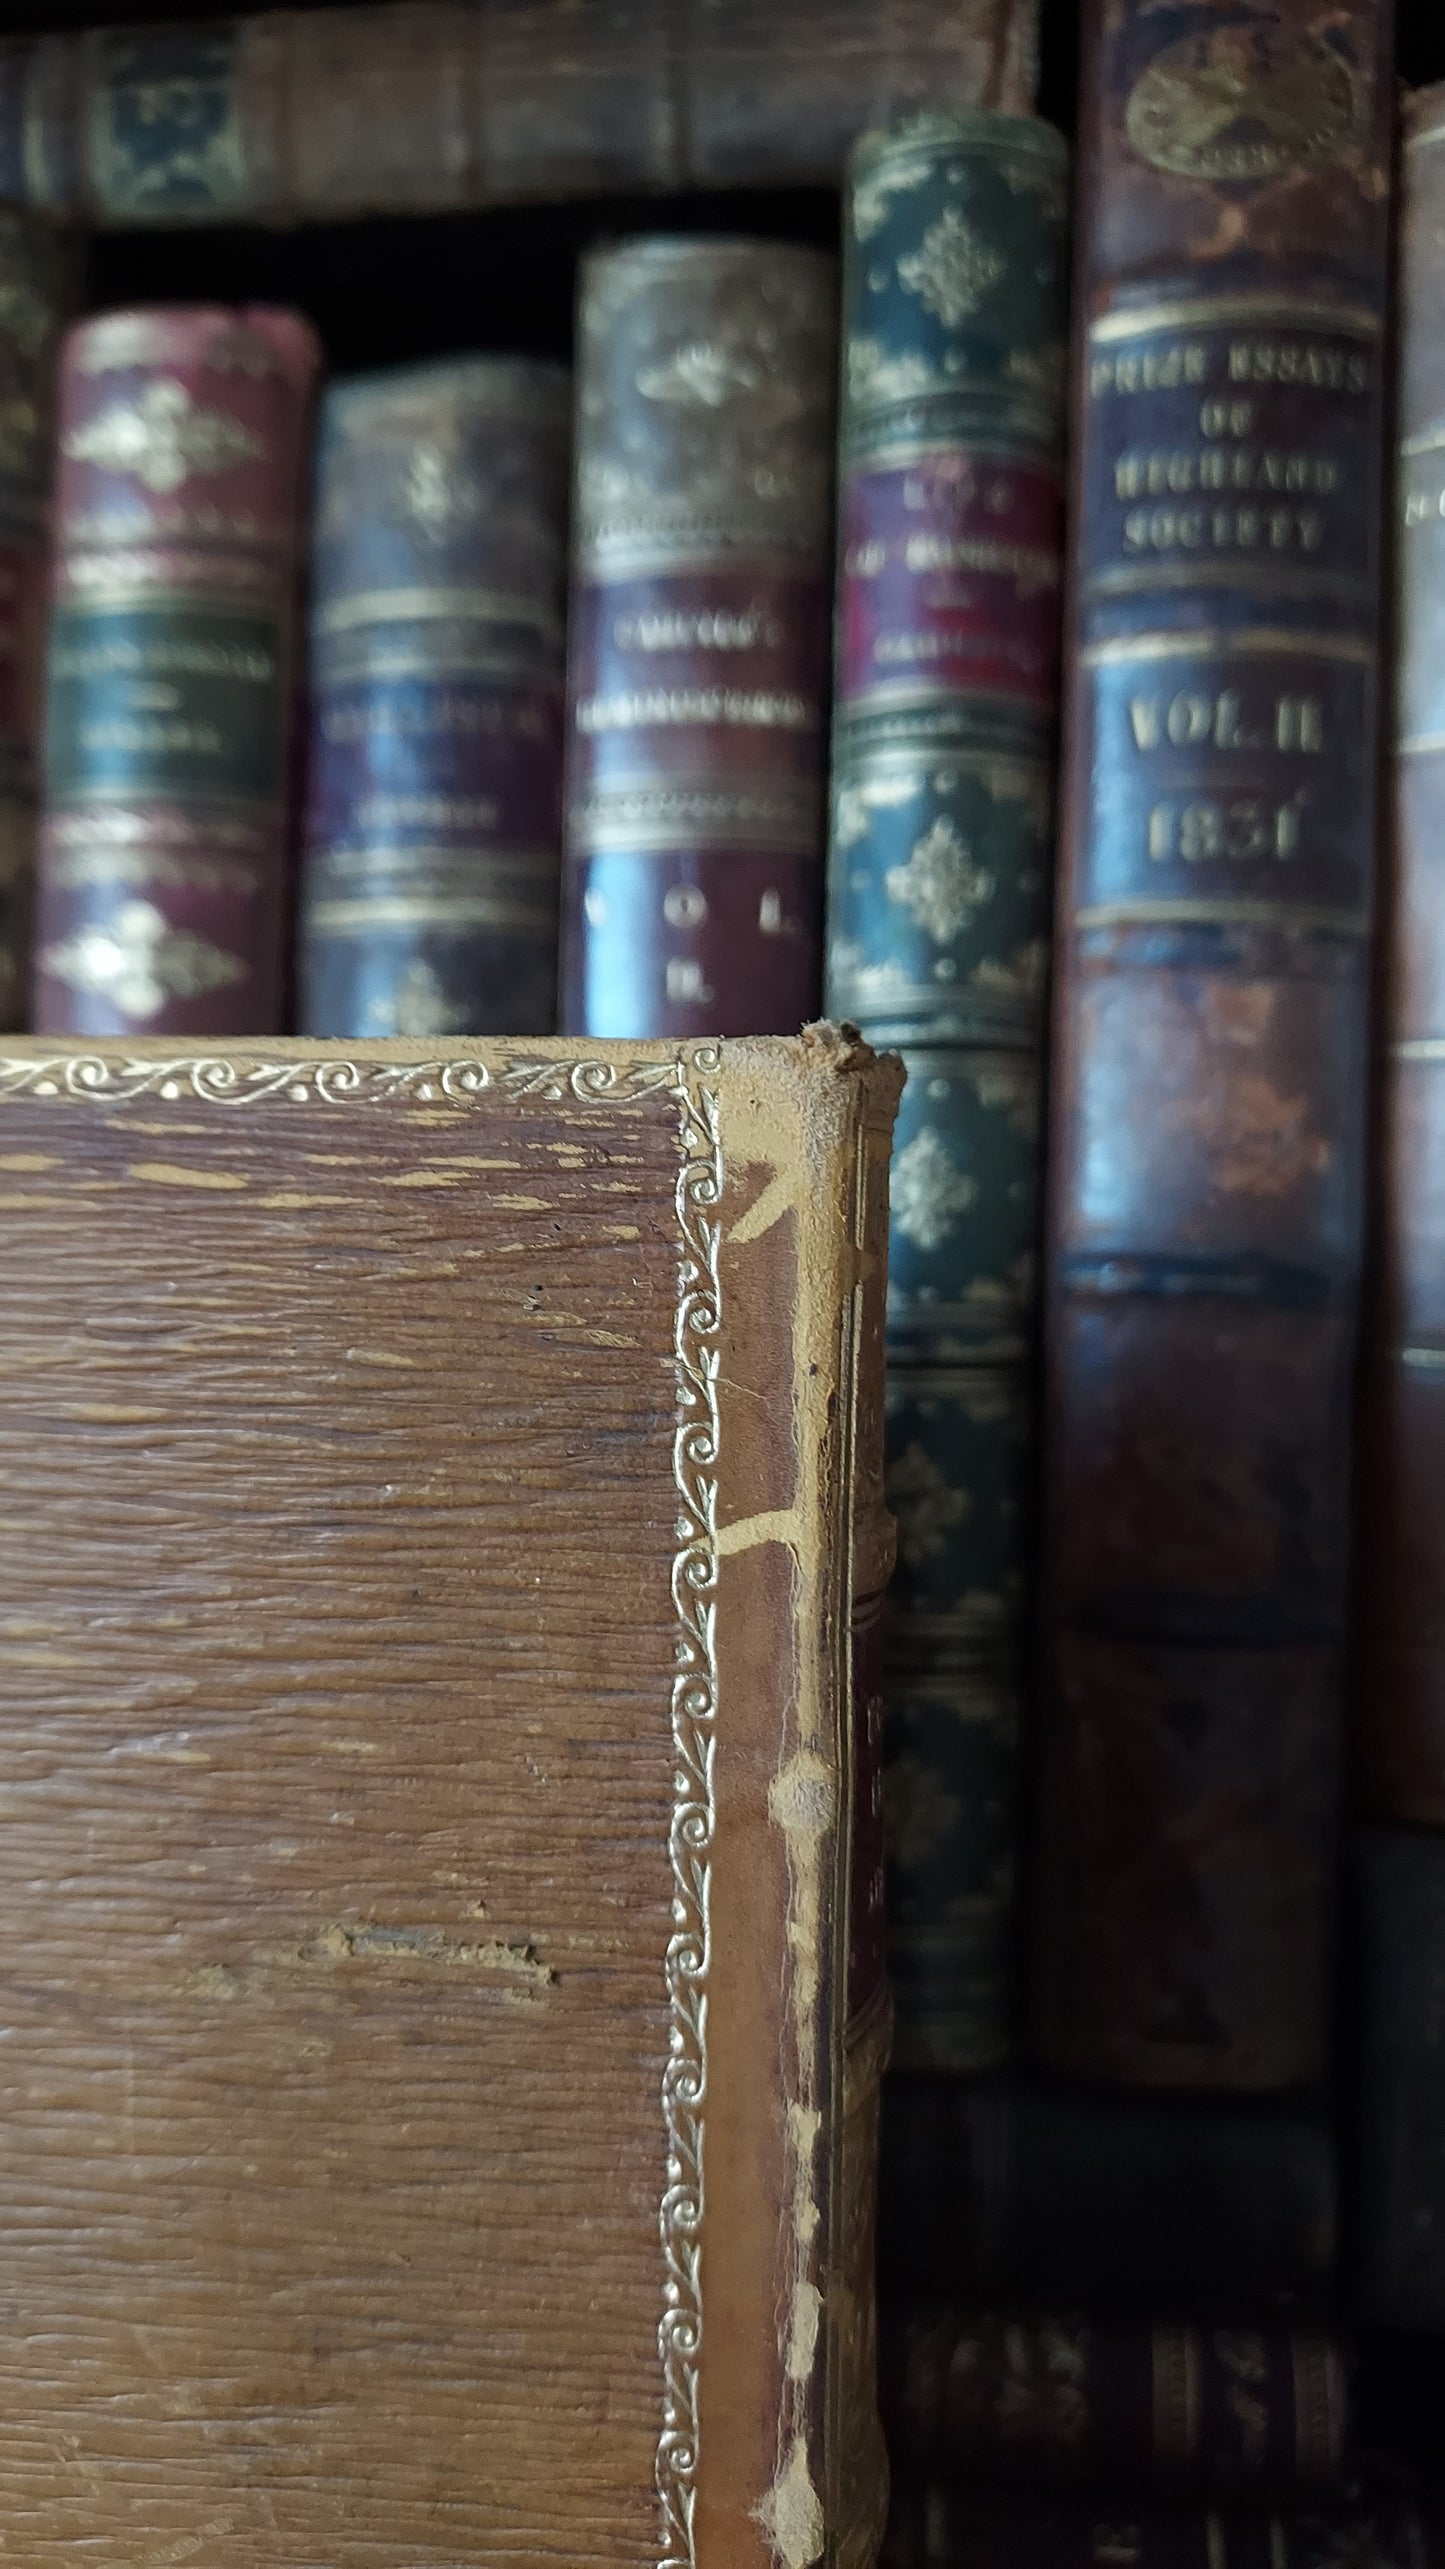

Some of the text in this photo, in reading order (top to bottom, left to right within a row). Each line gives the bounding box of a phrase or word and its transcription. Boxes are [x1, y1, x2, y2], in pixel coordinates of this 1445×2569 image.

[1090, 344, 1368, 397] PRIZE ESSAYS
[1114, 451, 1338, 500] HIGHLAND
[1123, 507, 1322, 551] SOCIETY
